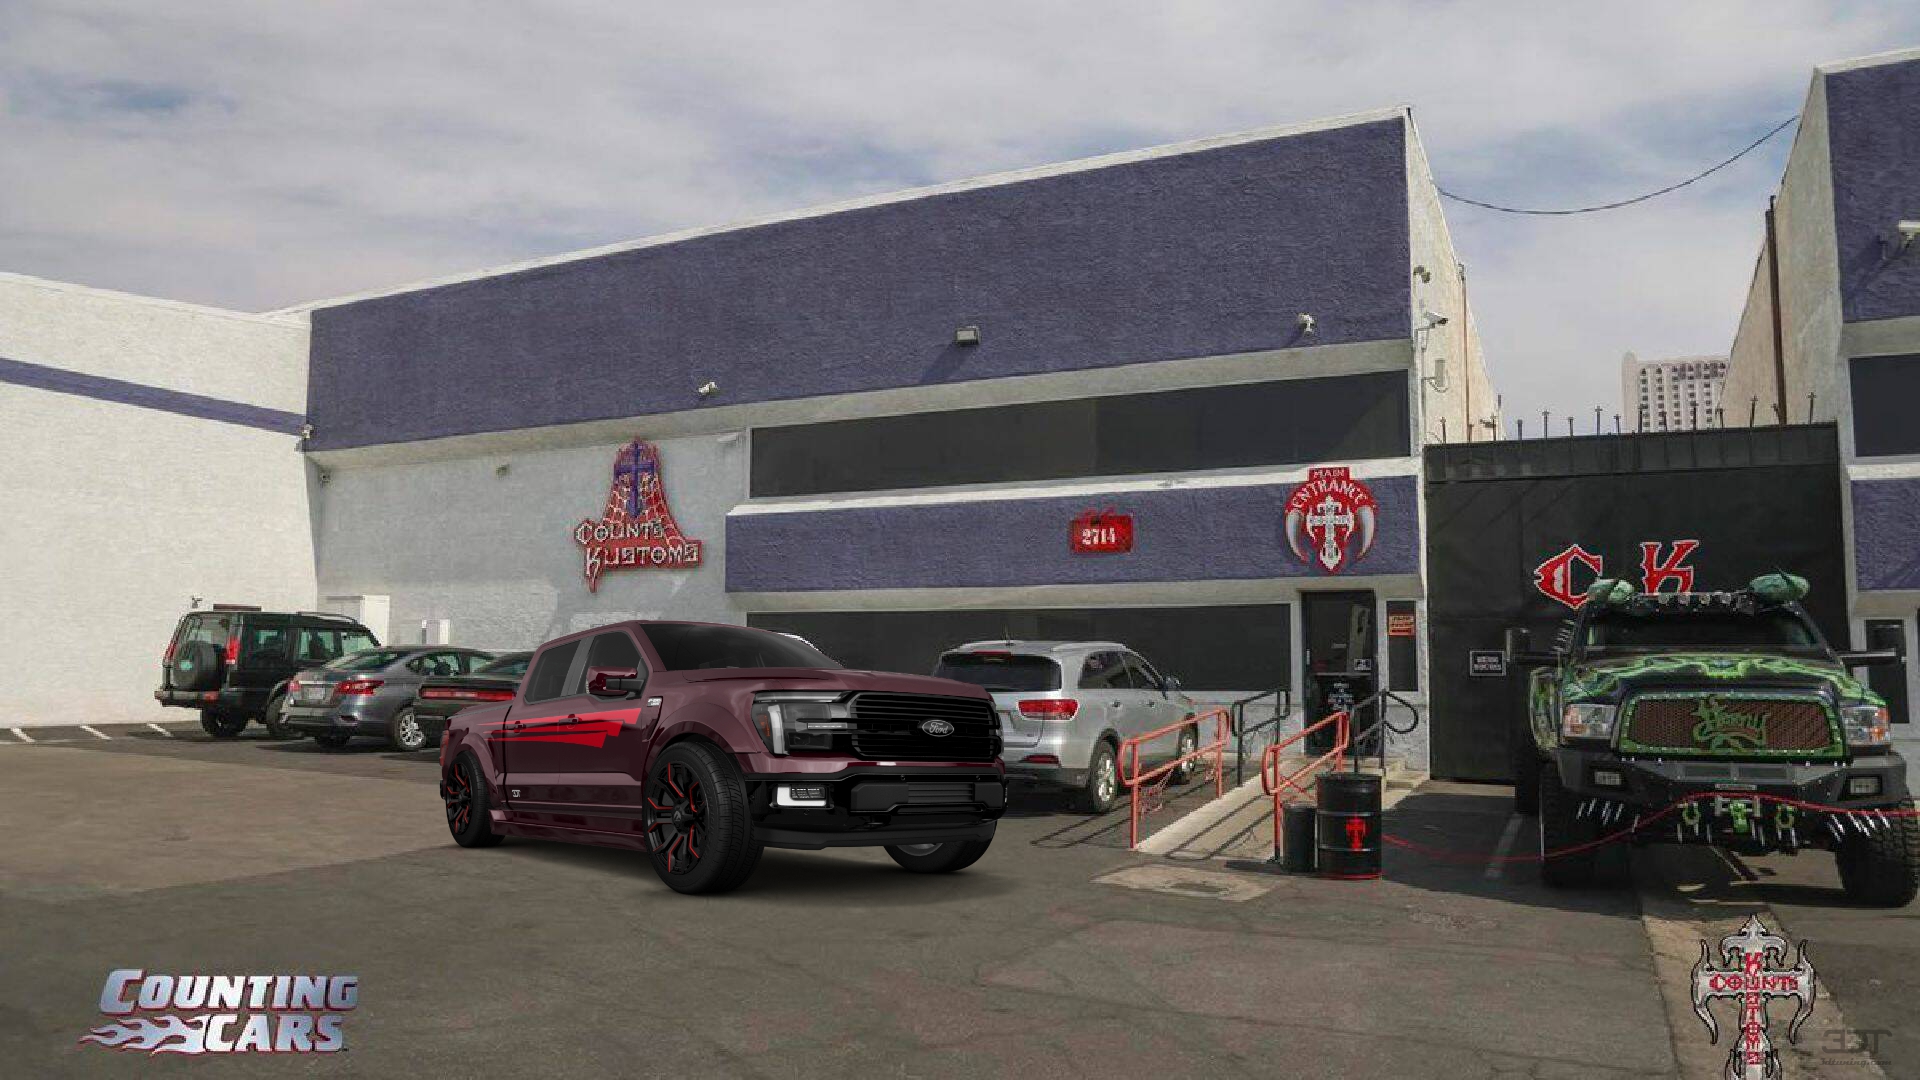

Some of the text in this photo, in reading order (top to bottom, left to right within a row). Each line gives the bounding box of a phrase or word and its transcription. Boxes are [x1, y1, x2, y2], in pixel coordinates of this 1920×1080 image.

[1313, 469, 1345, 478] MAIN
[1292, 480, 1368, 508] ENTRANCE
[1082, 527, 1116, 545] 2714
[585, 544, 700, 593] KUSTOMS
[1533, 539, 1700, 610] C K
[929, 721, 949, 734] Ford
